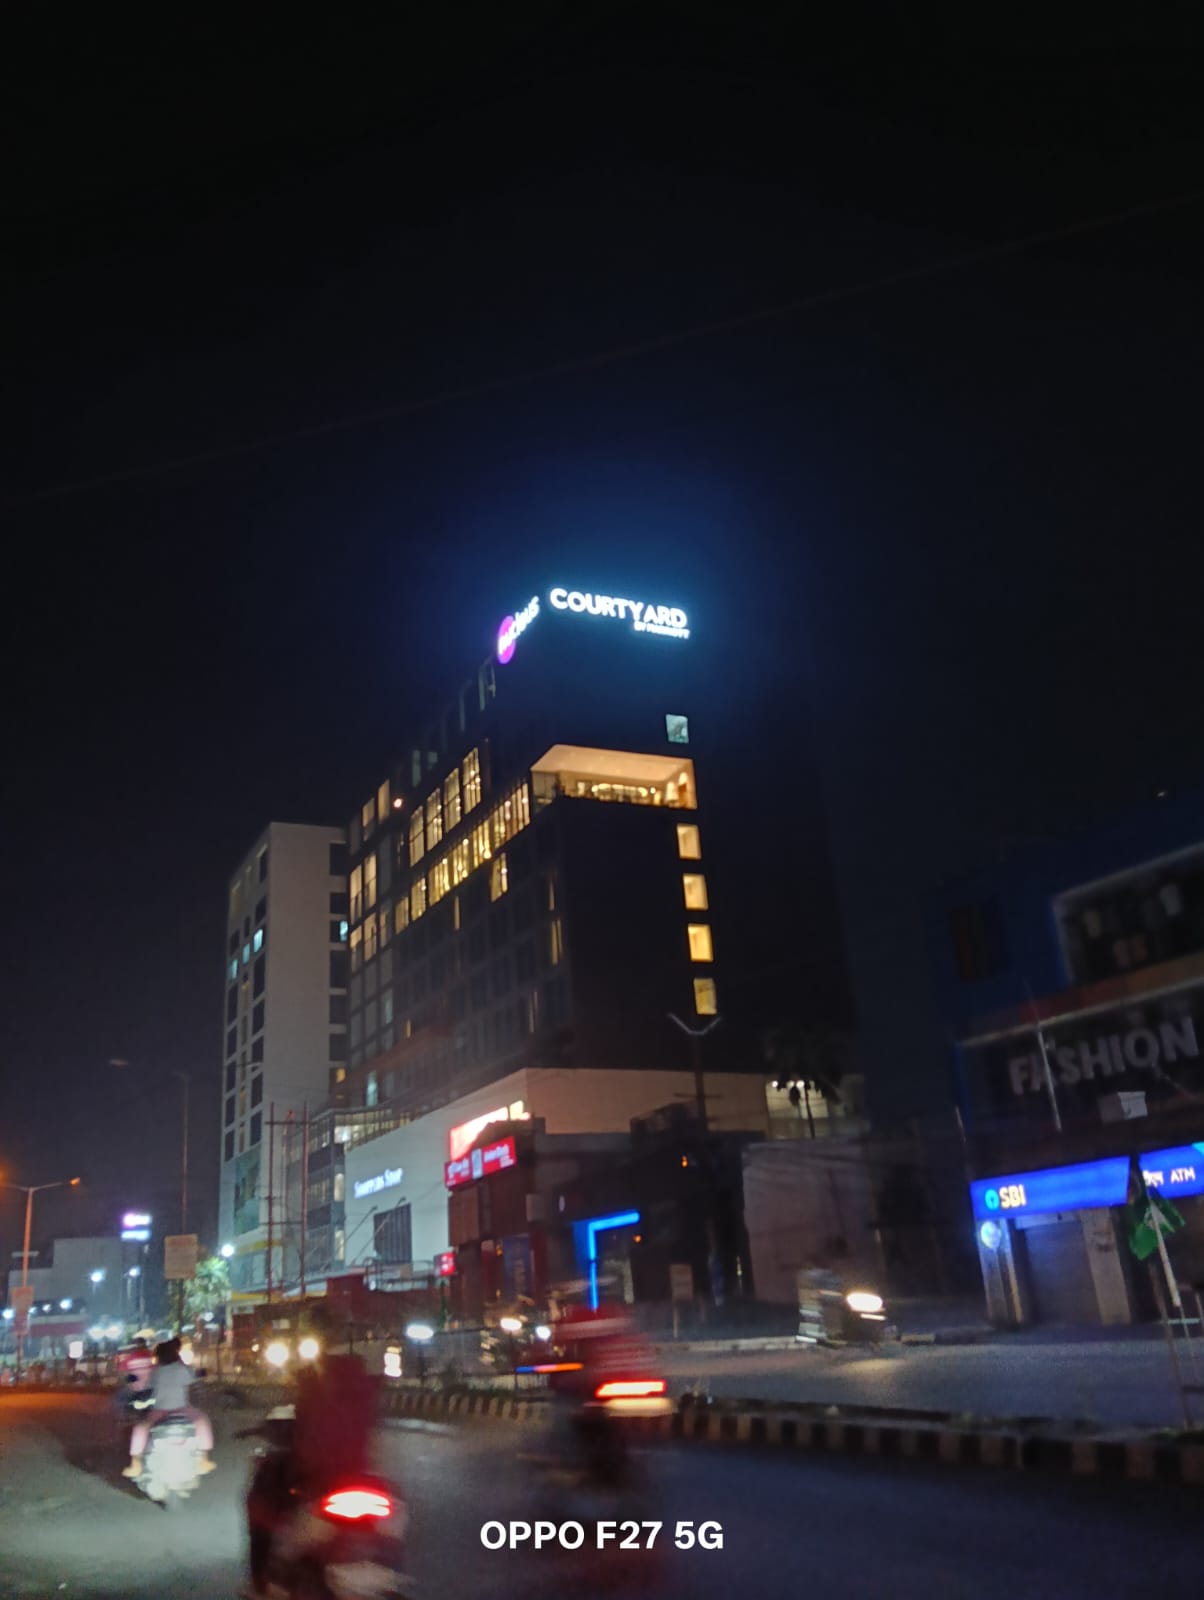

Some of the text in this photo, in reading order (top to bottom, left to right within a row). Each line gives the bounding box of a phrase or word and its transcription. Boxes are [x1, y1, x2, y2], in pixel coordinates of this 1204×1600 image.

[550, 588, 688, 628] COURTYARD
[1009, 1016, 1200, 1095] FASHION
[1171, 1166, 1196, 1184] ATM
[999, 1184, 1027, 1209] SBI
